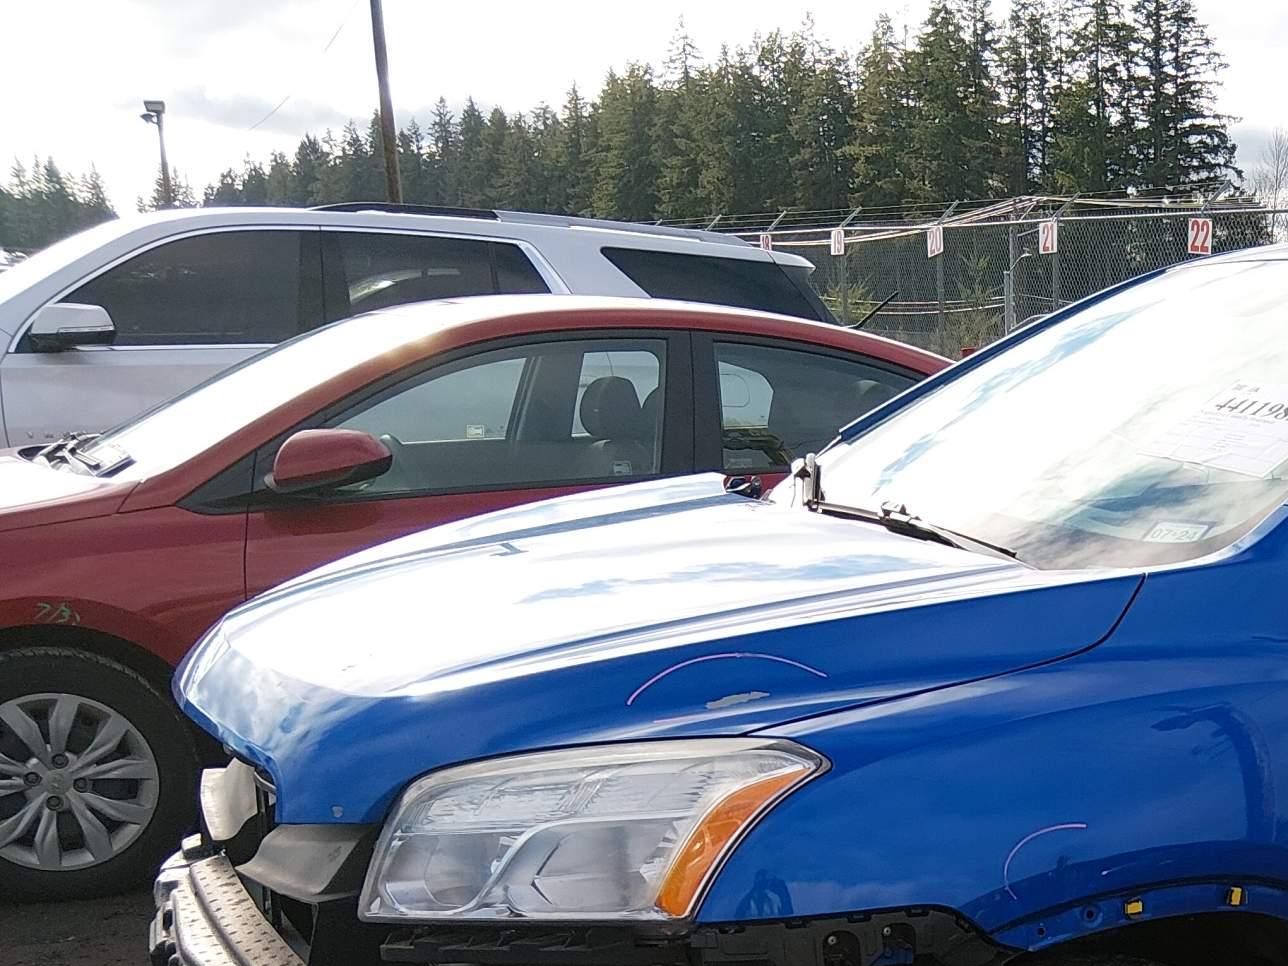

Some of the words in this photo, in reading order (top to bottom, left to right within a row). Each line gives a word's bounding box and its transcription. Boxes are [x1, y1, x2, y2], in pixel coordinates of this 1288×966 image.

[929, 227, 941, 255] 20
[1042, 223, 1055, 251] 21
[1190, 219, 1210, 252] 22
